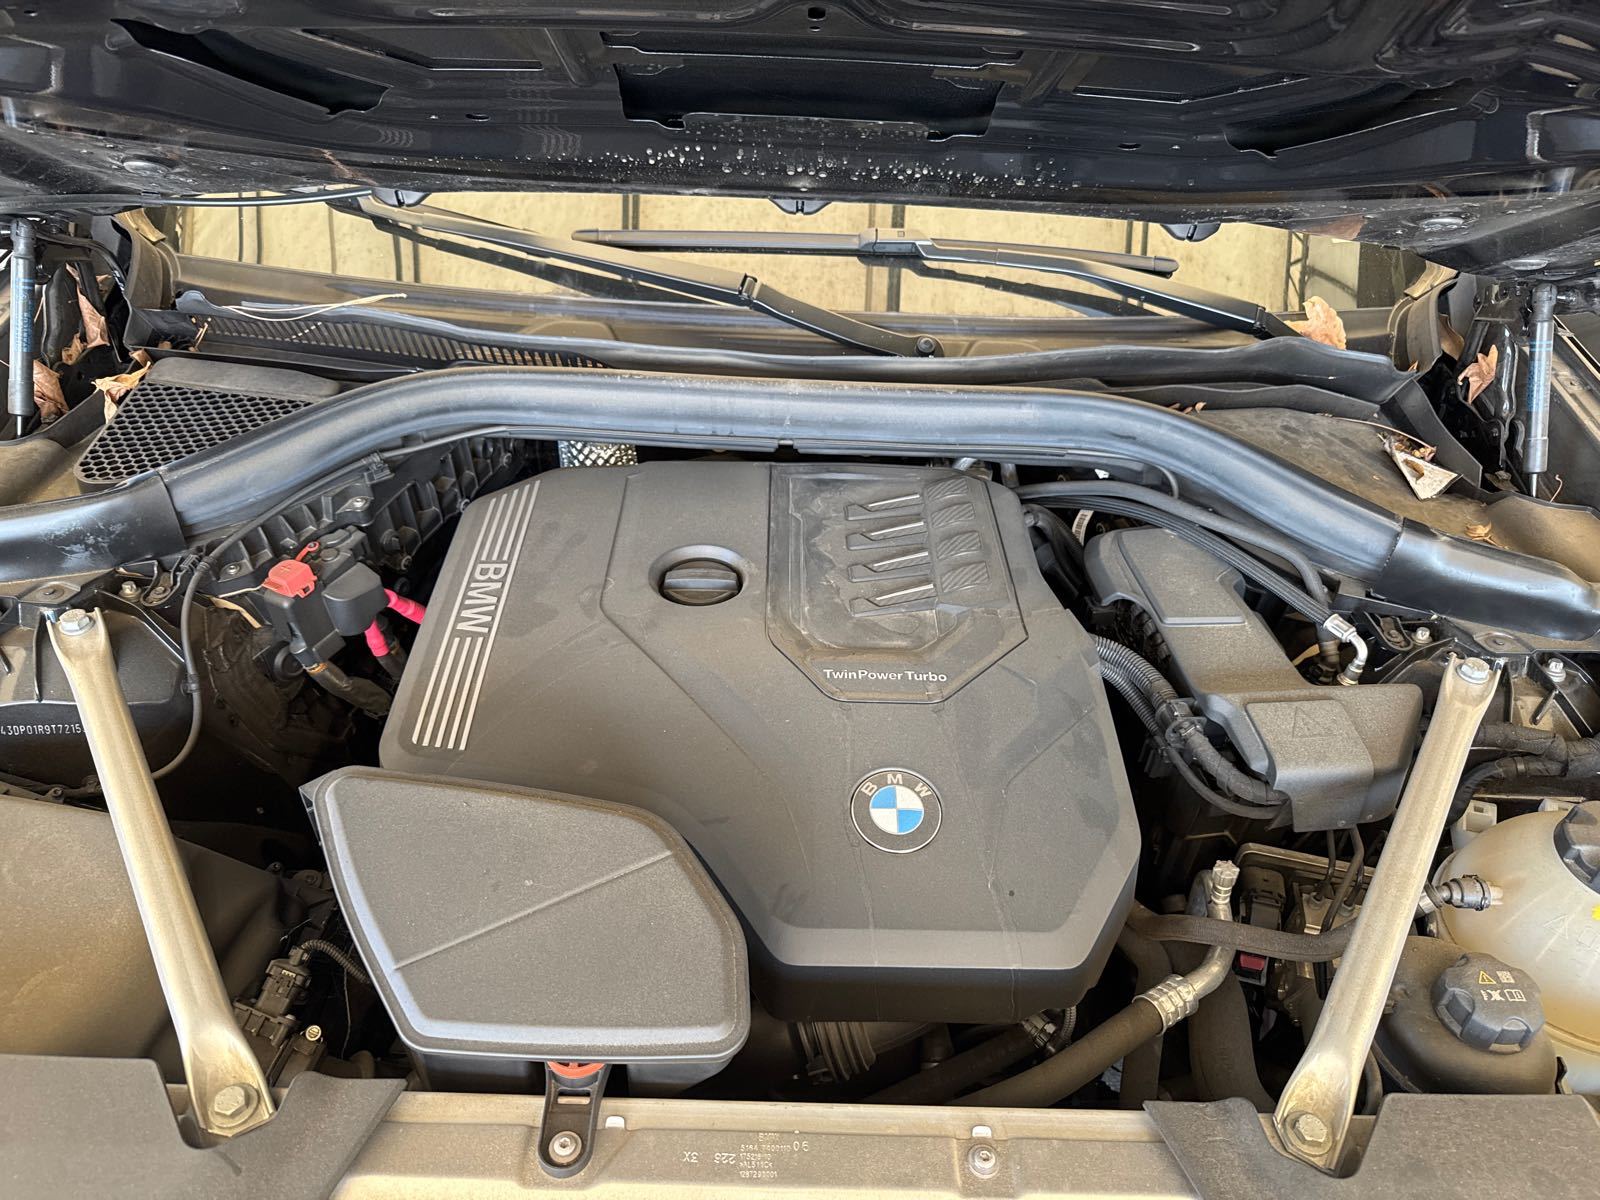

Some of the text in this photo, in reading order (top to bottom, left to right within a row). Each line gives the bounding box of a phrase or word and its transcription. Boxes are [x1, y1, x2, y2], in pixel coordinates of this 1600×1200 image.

[456, 563, 508, 633] BMW
[904, 670, 948, 682] Turbo
[0, 723, 85, 736] 43DP01R9T7215
[861, 773, 932, 797] BMW
